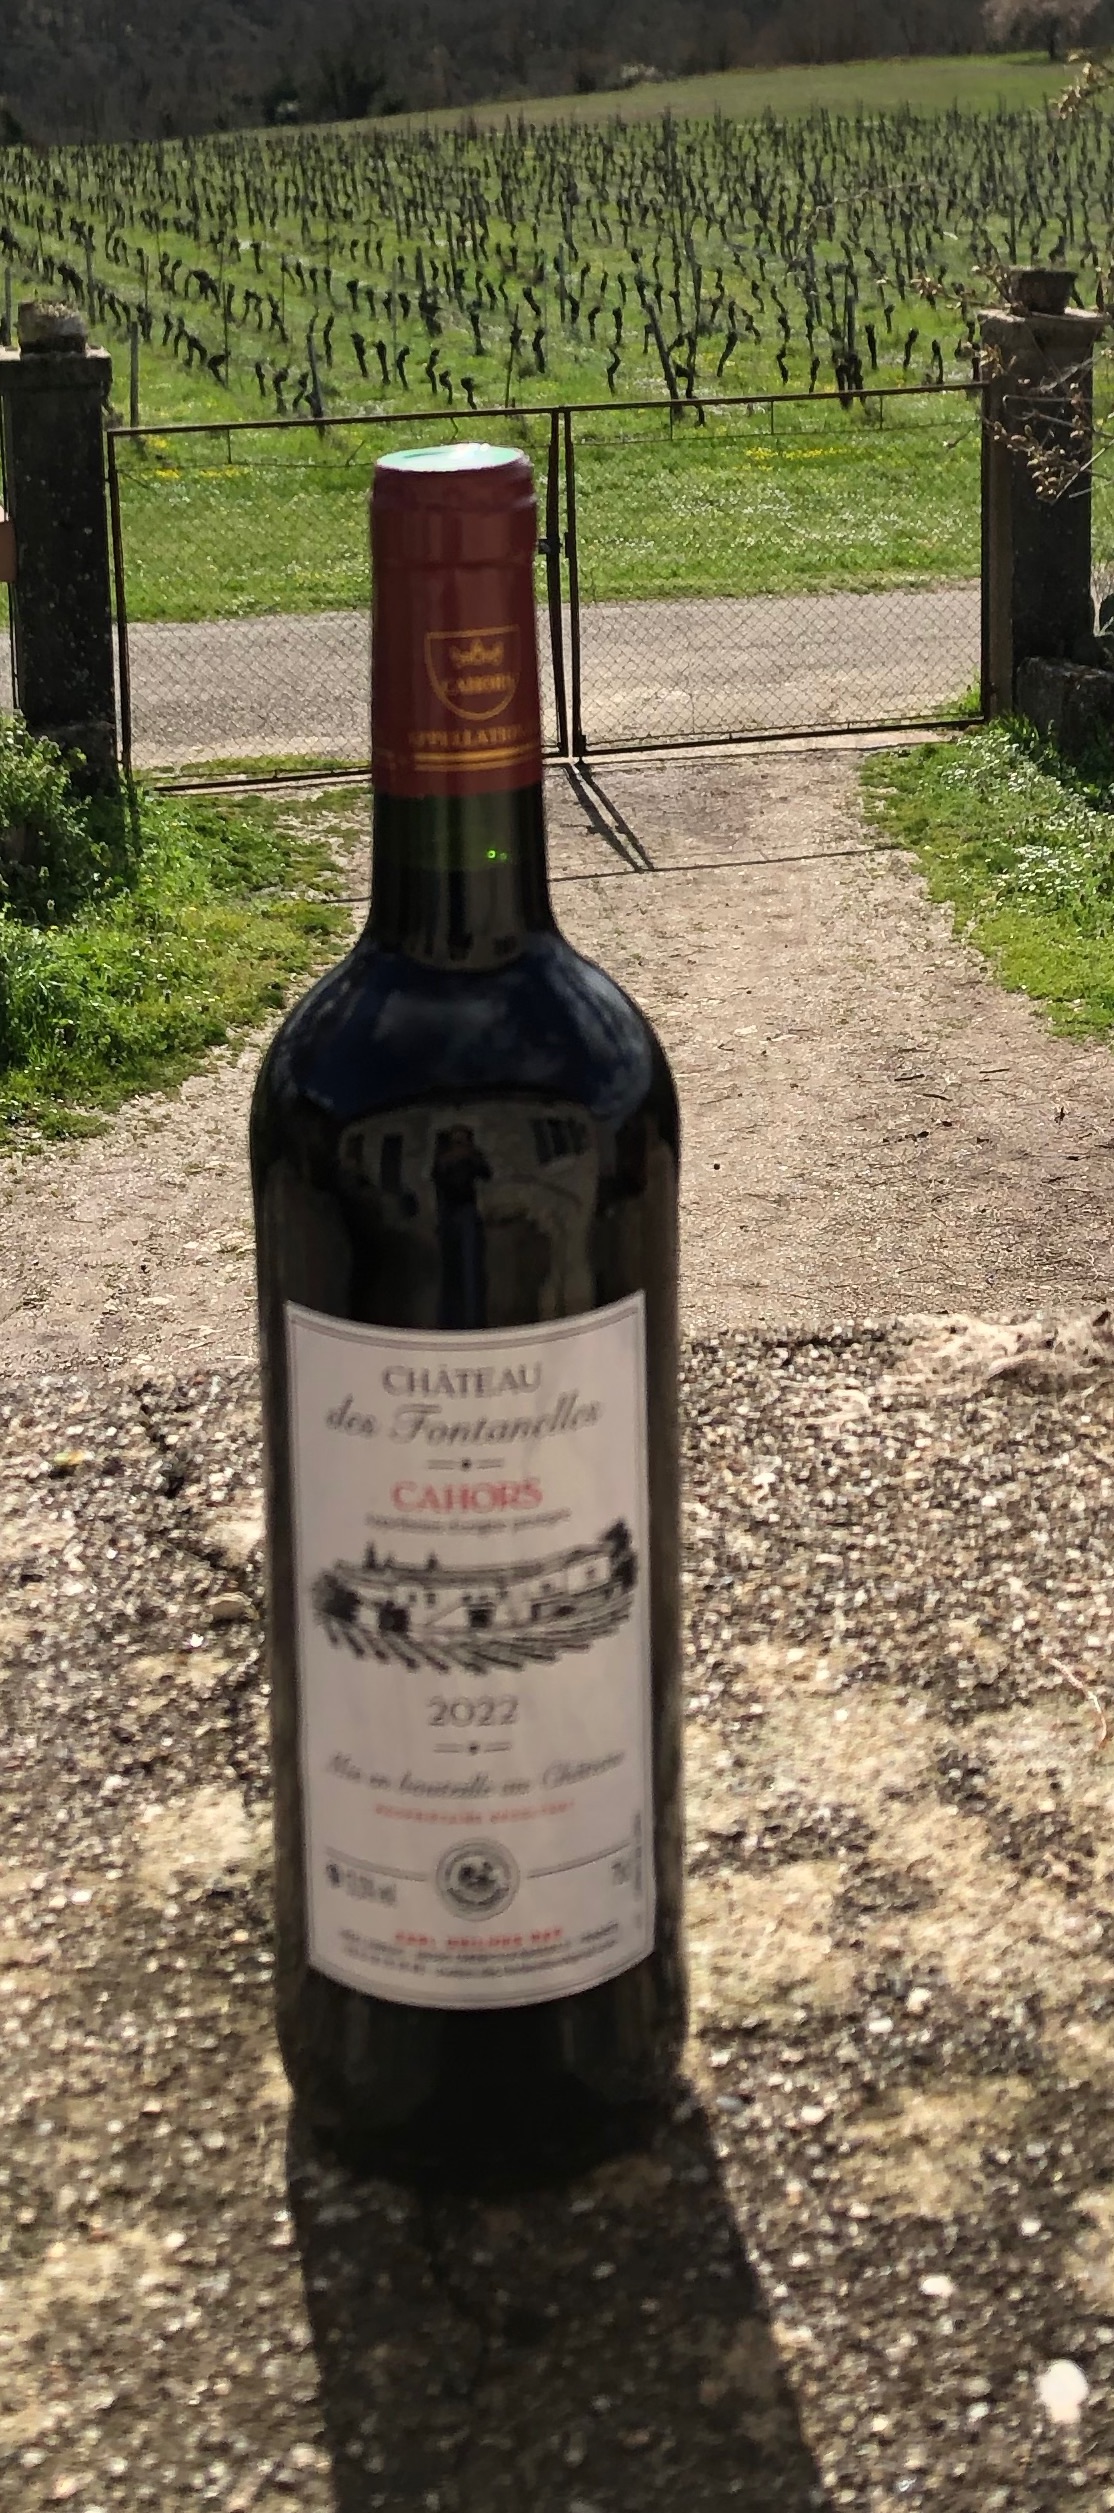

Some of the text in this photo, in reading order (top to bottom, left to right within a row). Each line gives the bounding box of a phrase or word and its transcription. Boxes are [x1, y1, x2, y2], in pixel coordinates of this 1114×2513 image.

[381, 1361, 542, 1398] CHÂTEAU
[325, 1389, 602, 1447] des Fontanelles
[391, 1478, 543, 1513] CAHORS
[428, 1696, 519, 1727] 2022
